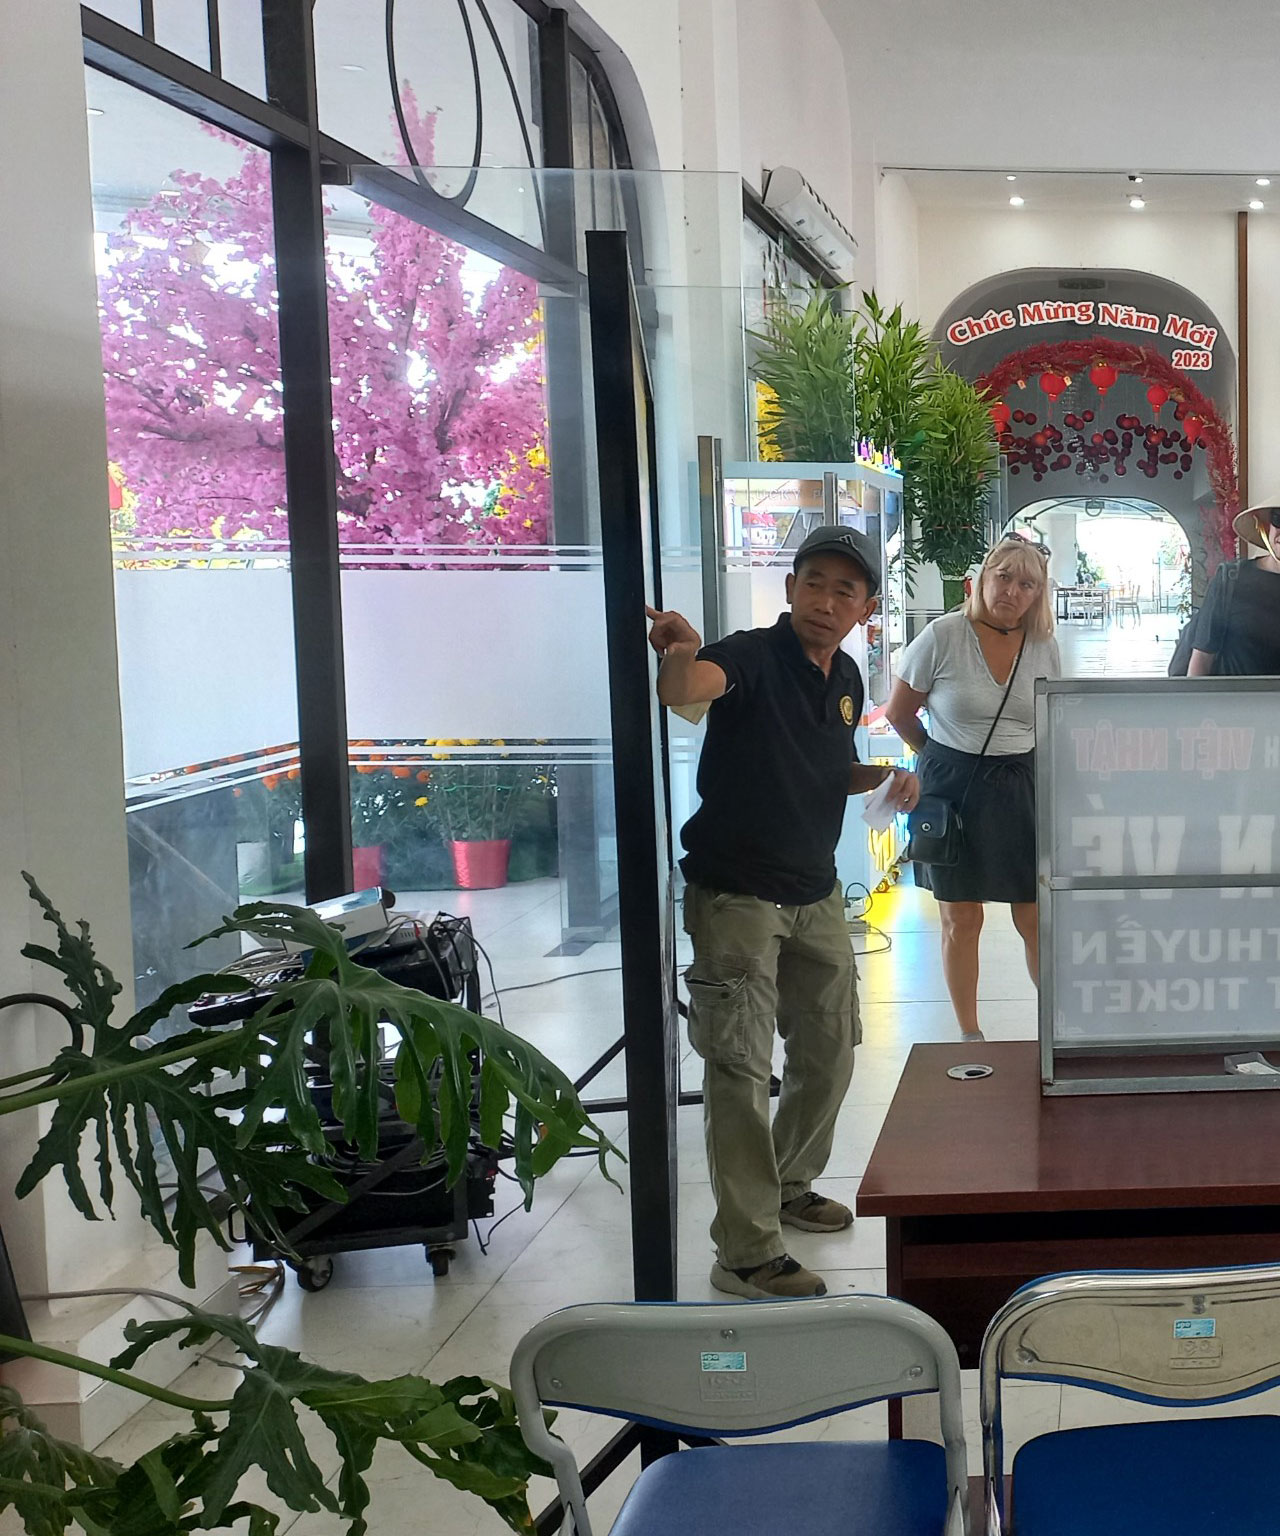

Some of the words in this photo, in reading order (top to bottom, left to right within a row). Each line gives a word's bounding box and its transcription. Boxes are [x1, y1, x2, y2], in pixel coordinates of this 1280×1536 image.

[948, 310, 1015, 345] Chúc
[1019, 302, 1094, 325] Mừng
[1100, 303, 1158, 332] Năm
[1164, 314, 1216, 349] Mới
[1173, 351, 1211, 369] 2023
